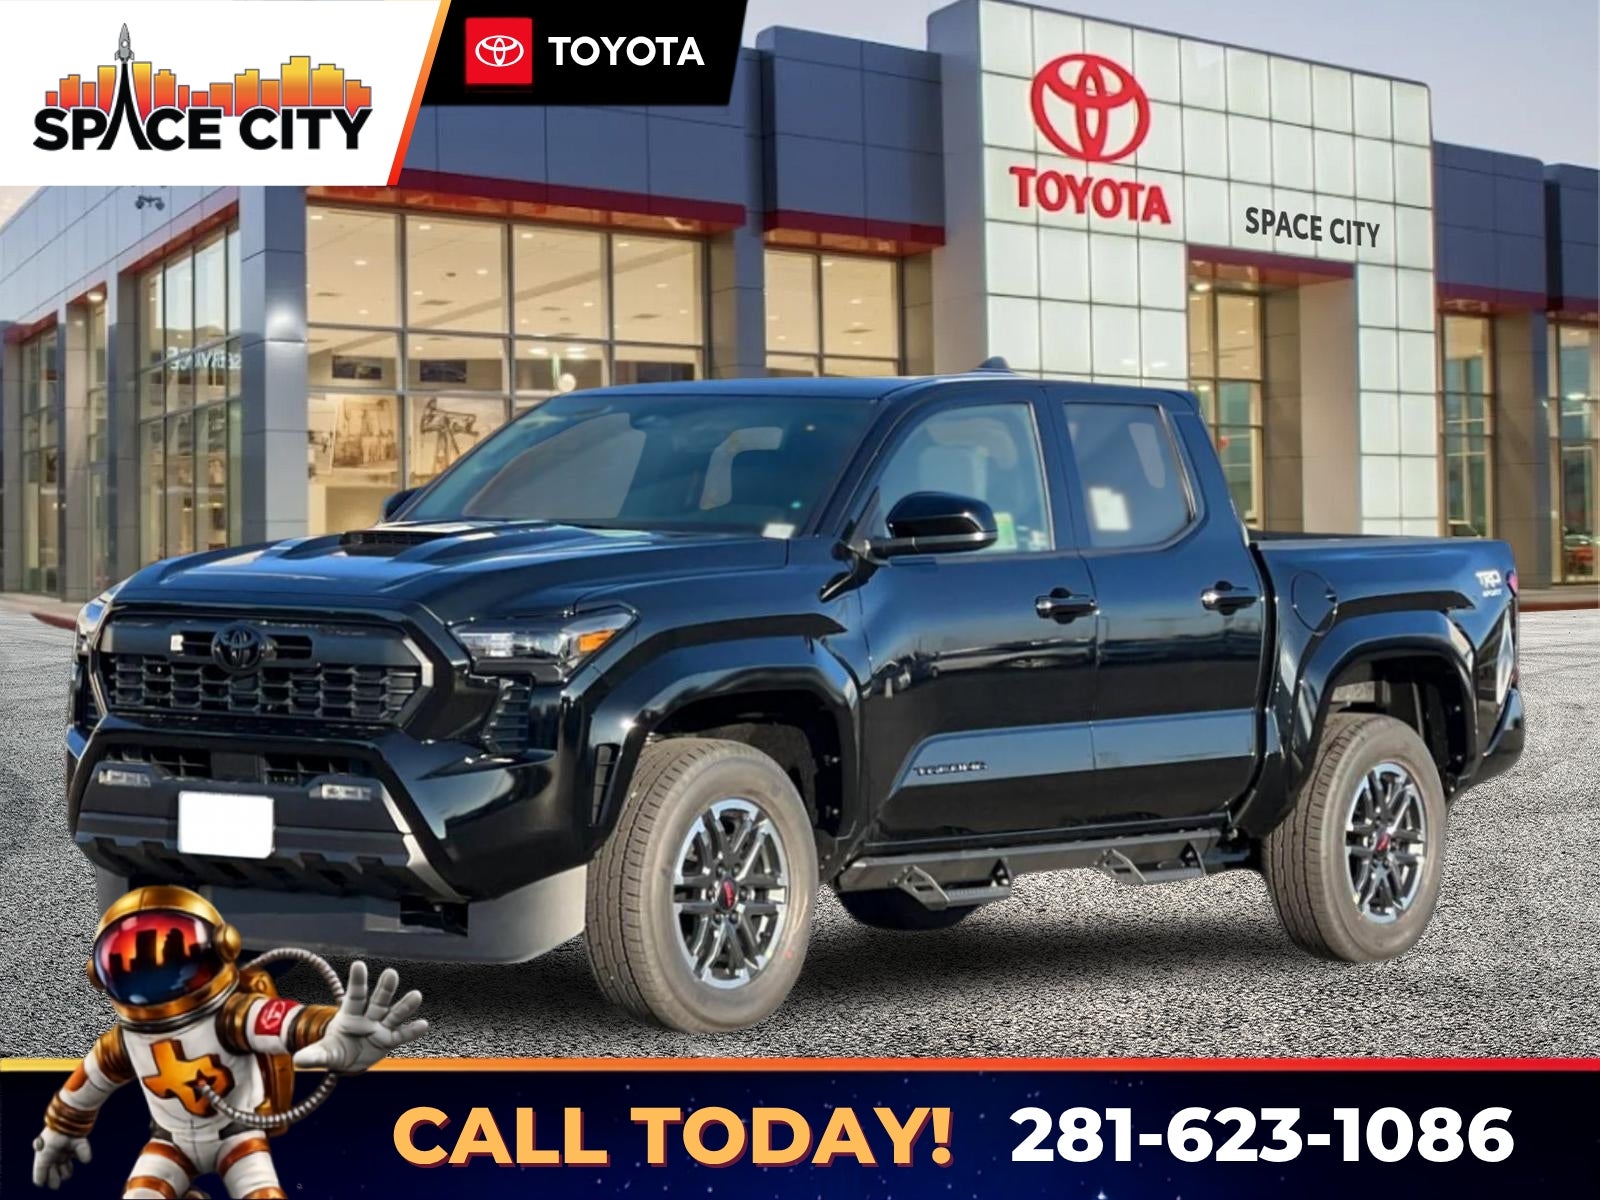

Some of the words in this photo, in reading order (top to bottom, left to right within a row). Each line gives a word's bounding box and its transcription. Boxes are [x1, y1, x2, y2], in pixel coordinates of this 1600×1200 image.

[1010, 165, 1171, 224] TOYOTA
[1245, 206, 1323, 242] SPACE
[1329, 218, 1380, 248] CITY
